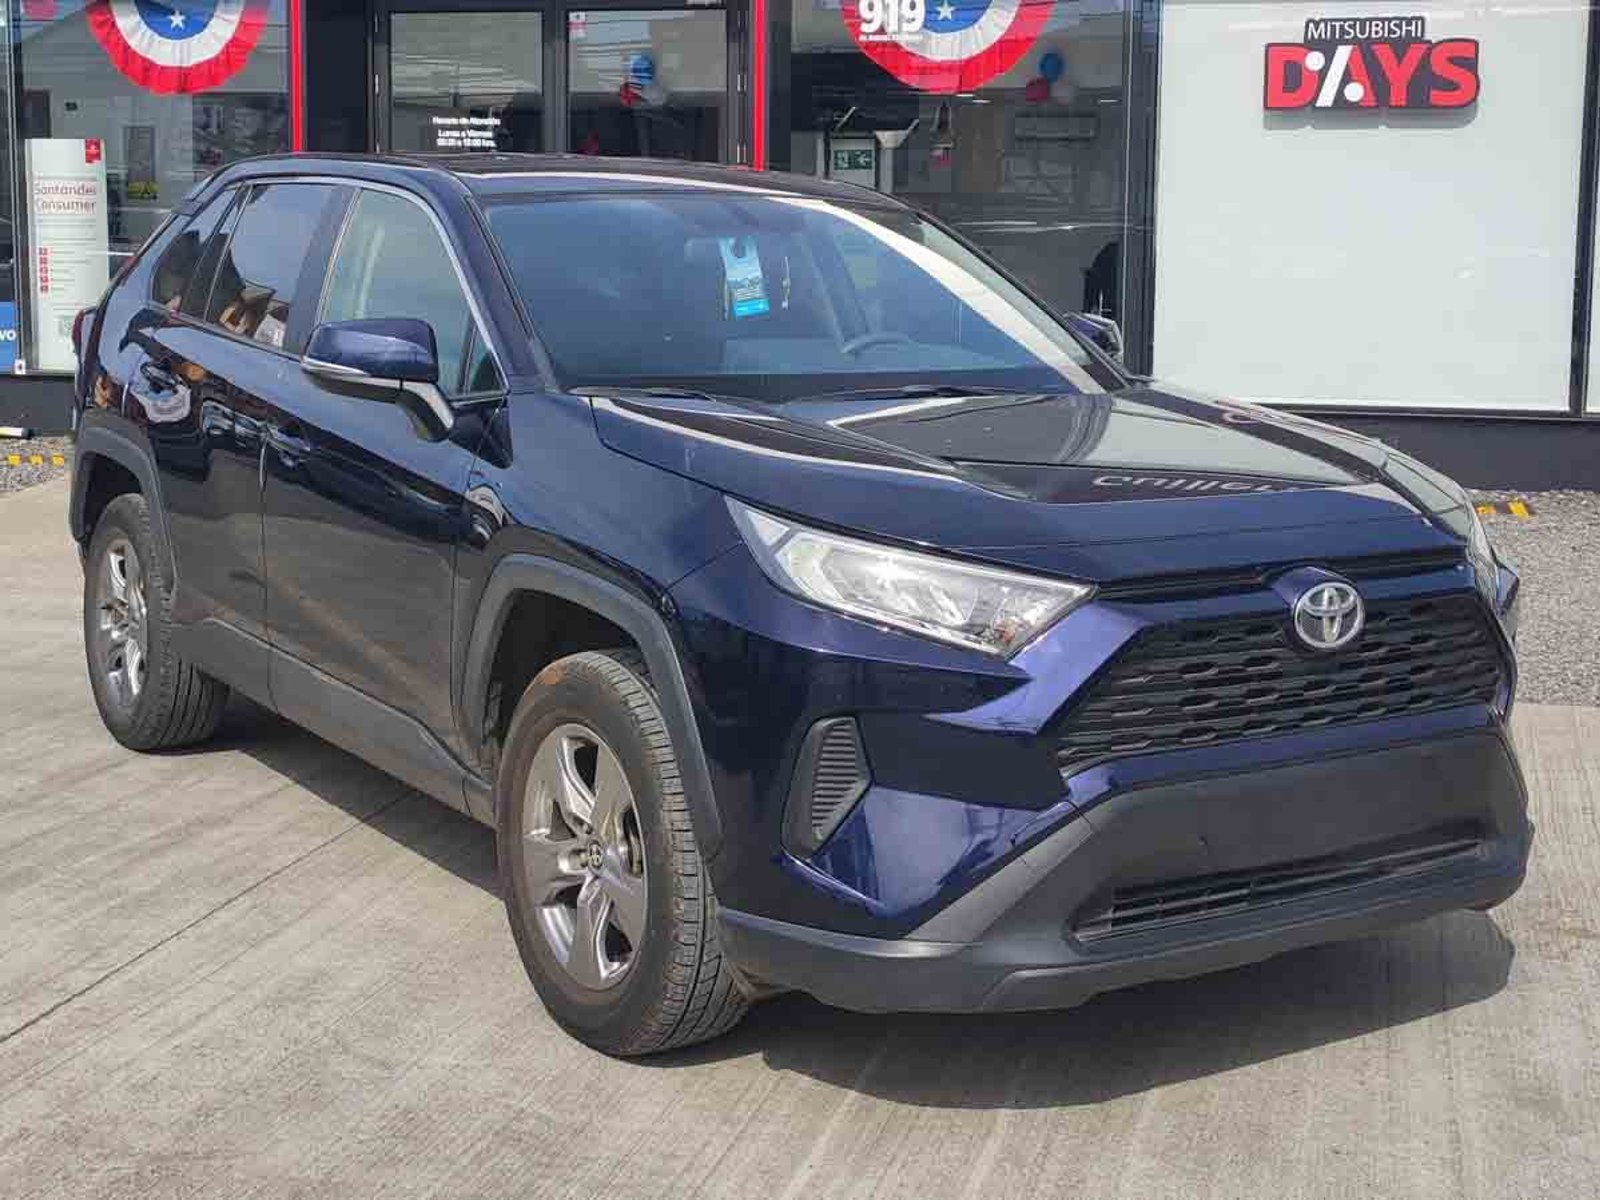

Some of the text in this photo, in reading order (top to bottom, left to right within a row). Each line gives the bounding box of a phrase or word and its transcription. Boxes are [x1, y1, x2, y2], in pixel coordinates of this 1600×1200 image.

[859, 0, 926, 33] 919
[1307, 20, 1422, 40] MITSUBISHI
[1266, 42, 1478, 107] DAYS
[33, 199, 97, 212] Consumer
